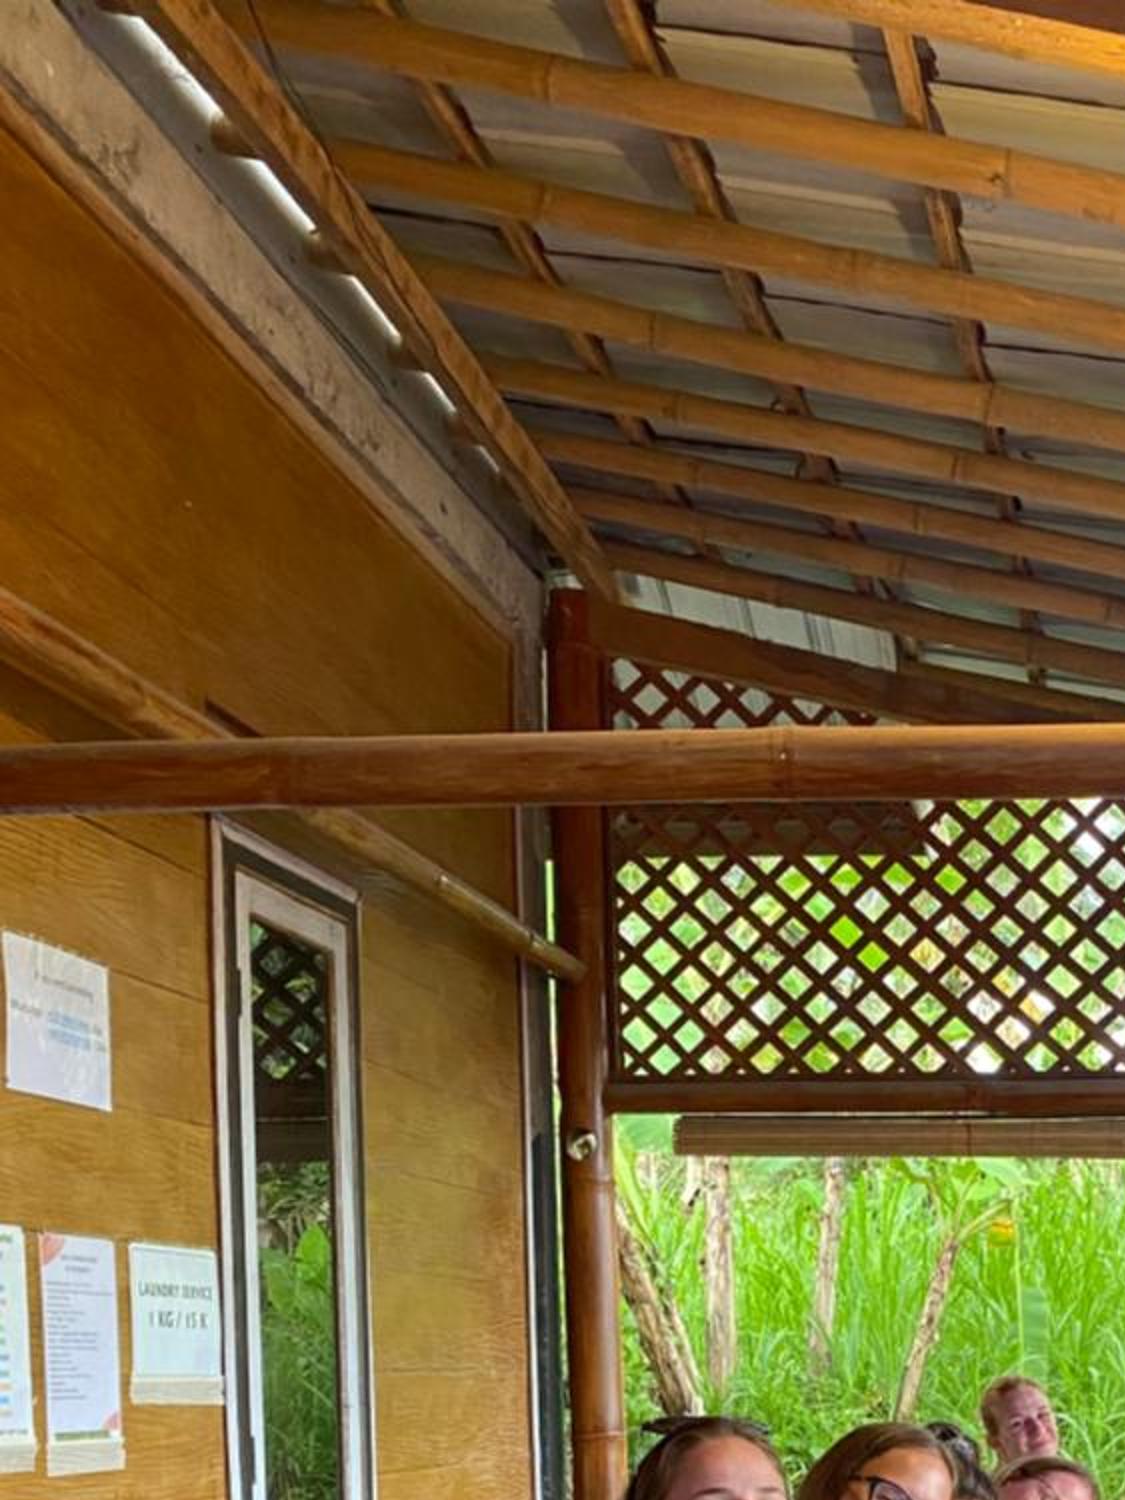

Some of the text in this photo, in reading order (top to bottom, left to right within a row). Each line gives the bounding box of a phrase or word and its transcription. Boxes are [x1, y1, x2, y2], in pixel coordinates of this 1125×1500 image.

[138, 1281, 180, 1298] LAUNDRY
[158, 1311, 175, 1329] KG
[185, 1312, 198, 1329] 15
[200, 1312, 208, 1329] K
